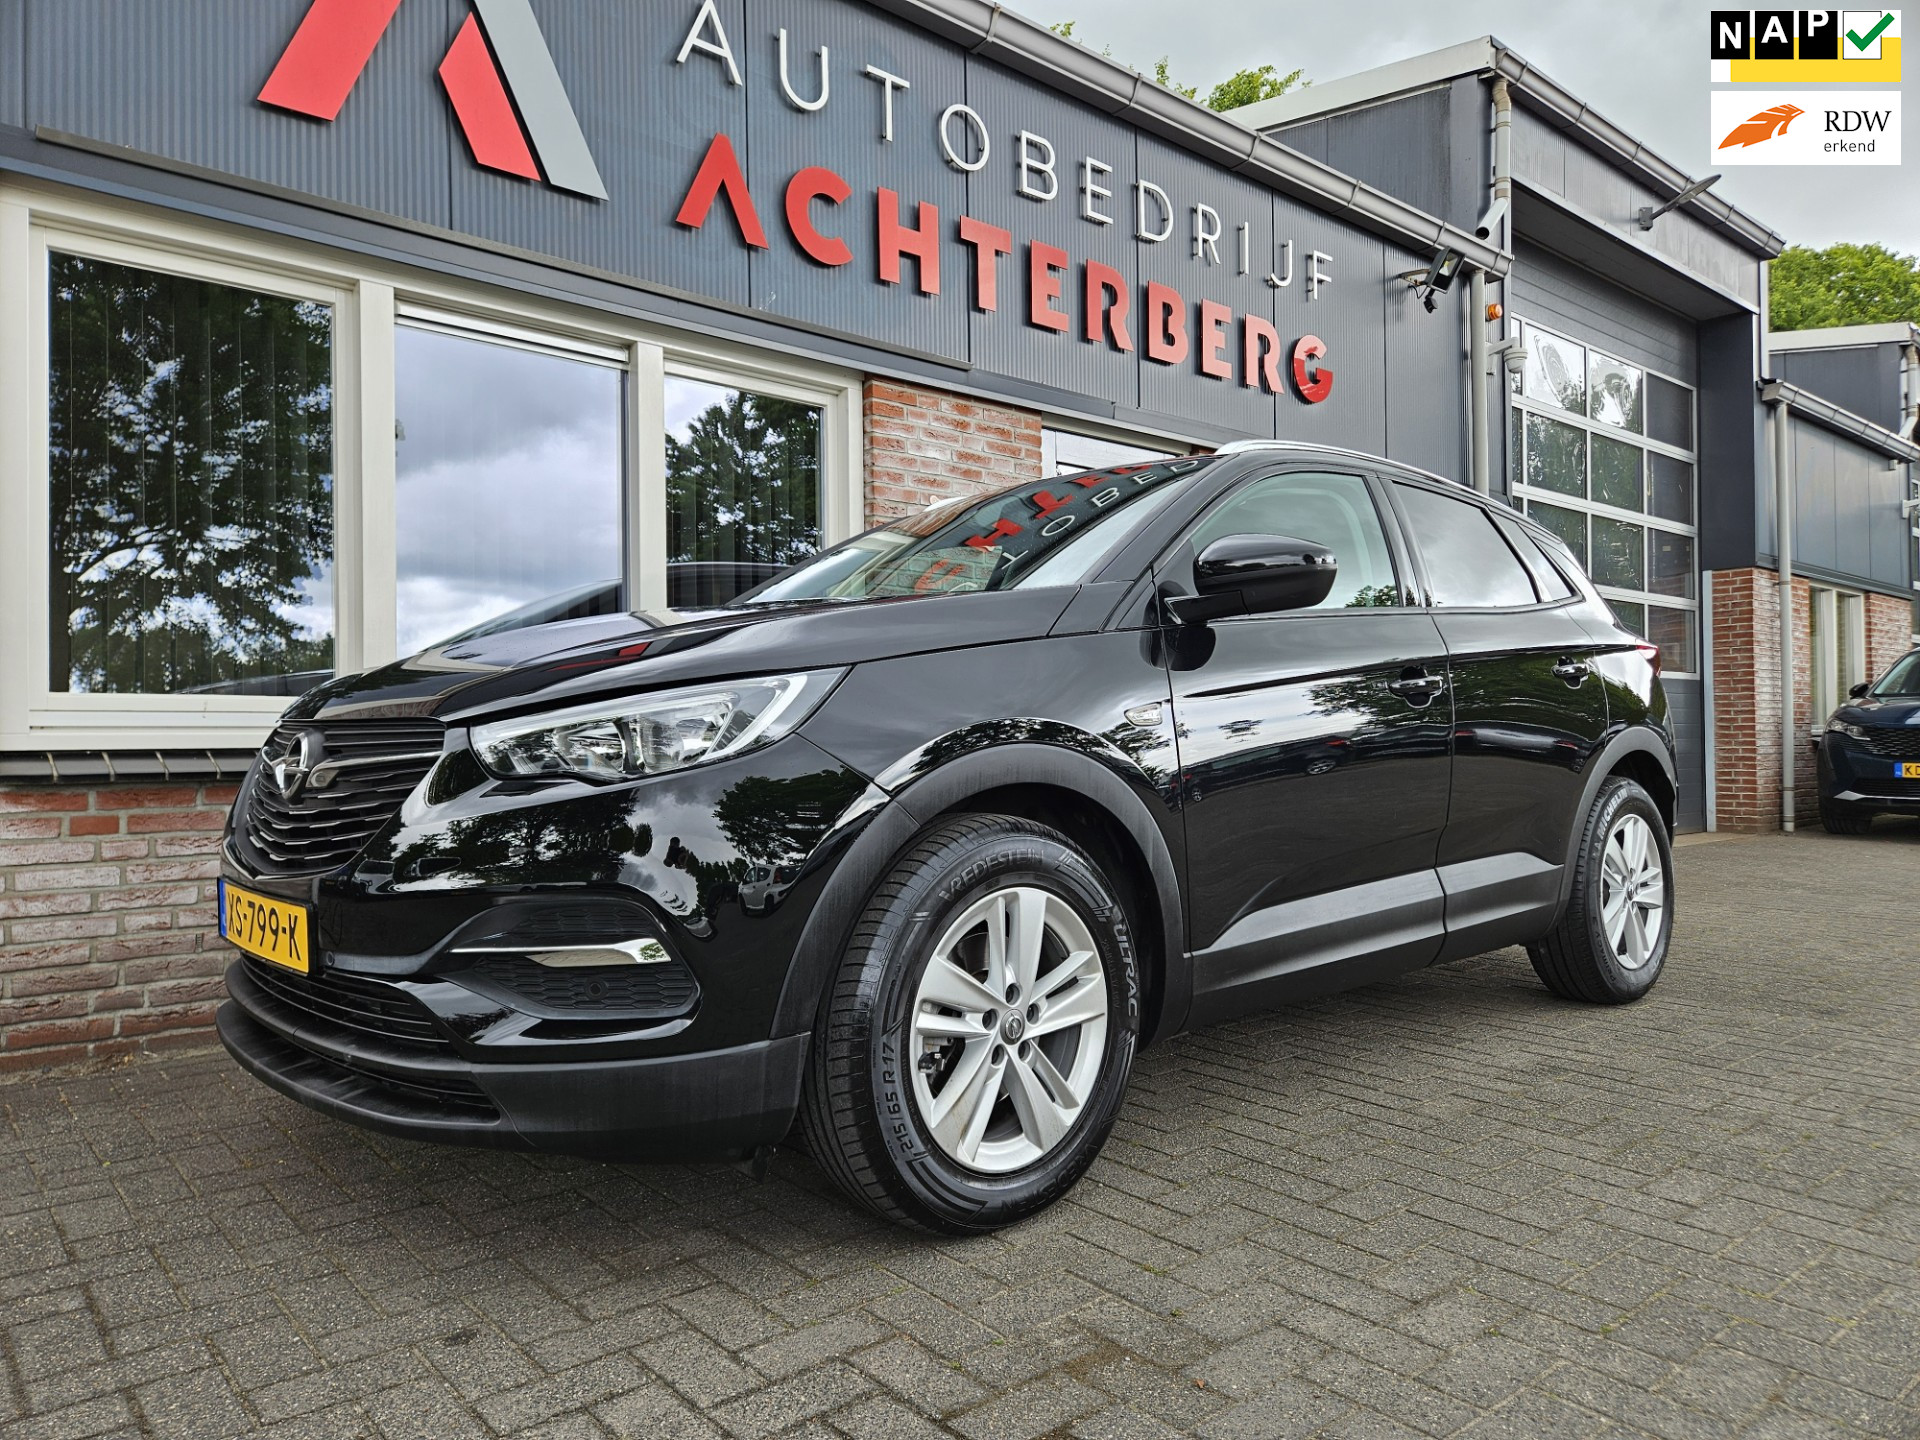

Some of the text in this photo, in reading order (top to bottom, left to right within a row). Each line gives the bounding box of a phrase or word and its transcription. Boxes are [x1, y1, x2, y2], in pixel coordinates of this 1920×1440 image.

[676, 0, 1334, 300] AUTOBEDRIJF
[676, 133, 1334, 403] ACHTERBERG
[1597, 788, 1627, 840] MICHELIN
[939, 848, 1045, 901] VREDESTEIN
[227, 891, 302, 961] XS-799-K
[1113, 923, 1137, 1017] ULTRAC
[882, 1042, 895, 1066] 17
[882, 1070, 896, 1084] R
[884, 1091, 914, 1153] 215/65
